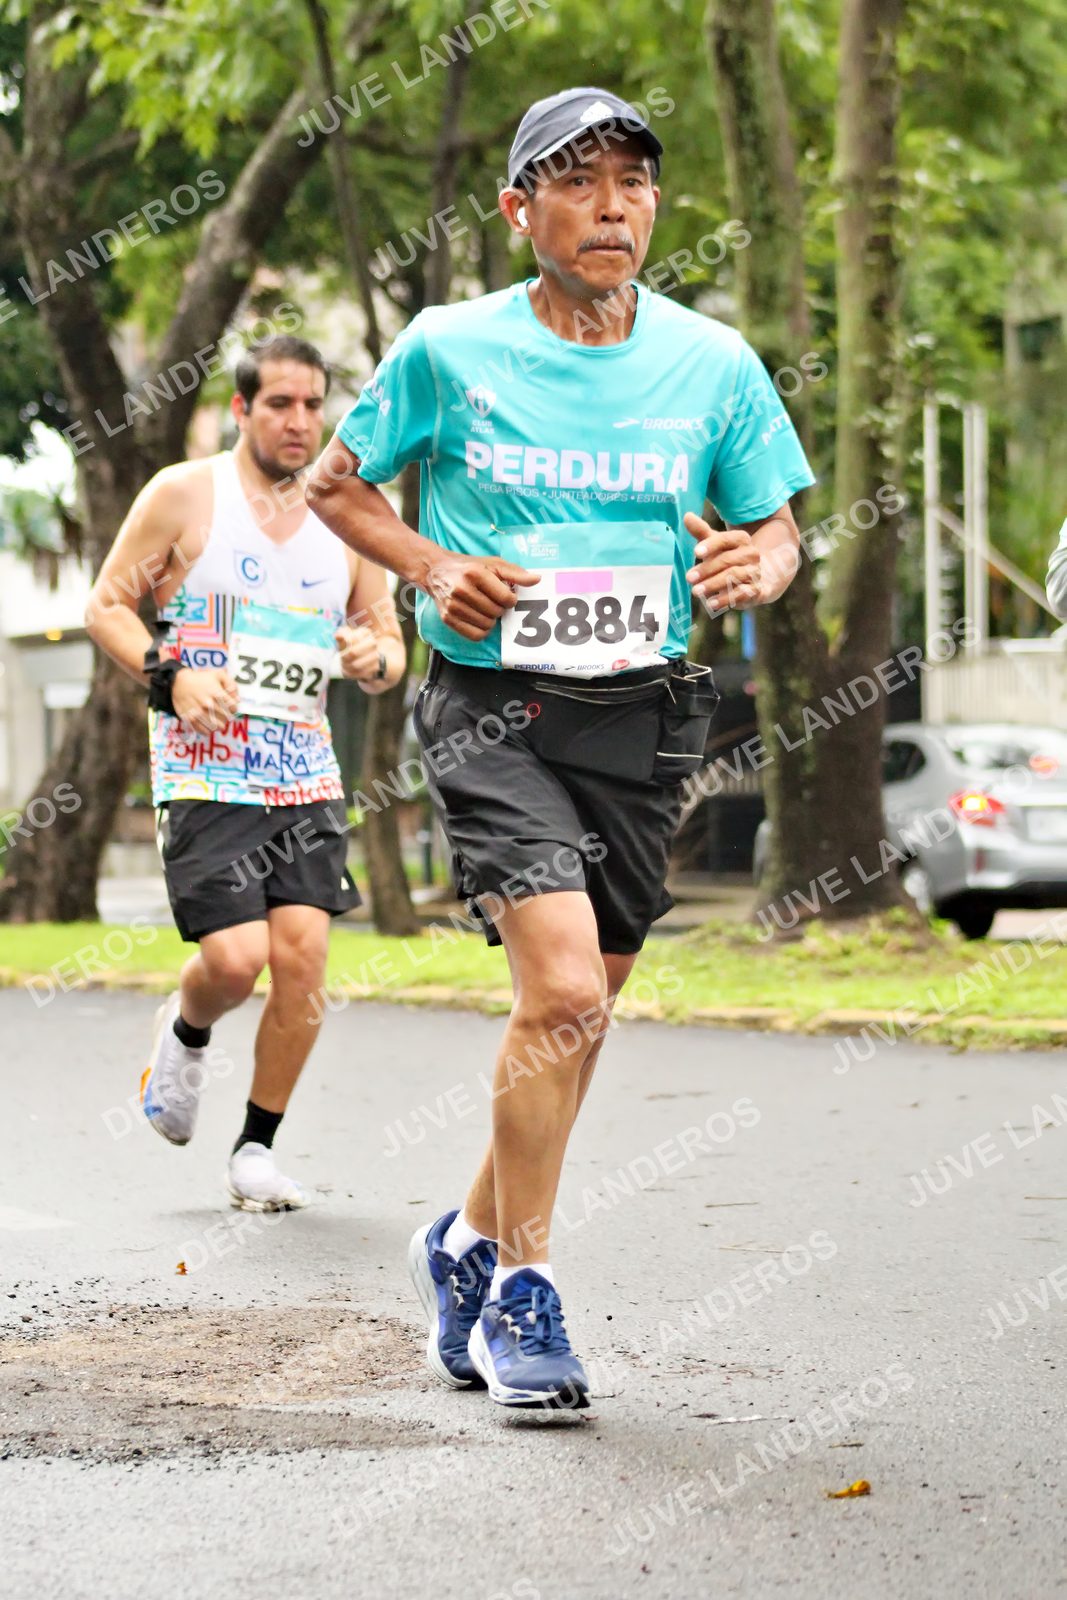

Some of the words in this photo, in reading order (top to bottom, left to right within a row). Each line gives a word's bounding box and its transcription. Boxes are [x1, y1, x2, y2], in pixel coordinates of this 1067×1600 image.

[470, 426, 495, 434] ATLAS
[642, 418, 704, 430] BROOKS
[465, 440, 690, 493] PERDURA
[478, 483, 503, 493] PEGA
[505, 486, 540, 498] PISOS
[513, 595, 660, 648] 3884
[514, 663, 556, 671] PERDURA
[577, 663, 605, 672] BROOKS
[234, 655, 323, 697] 3292
